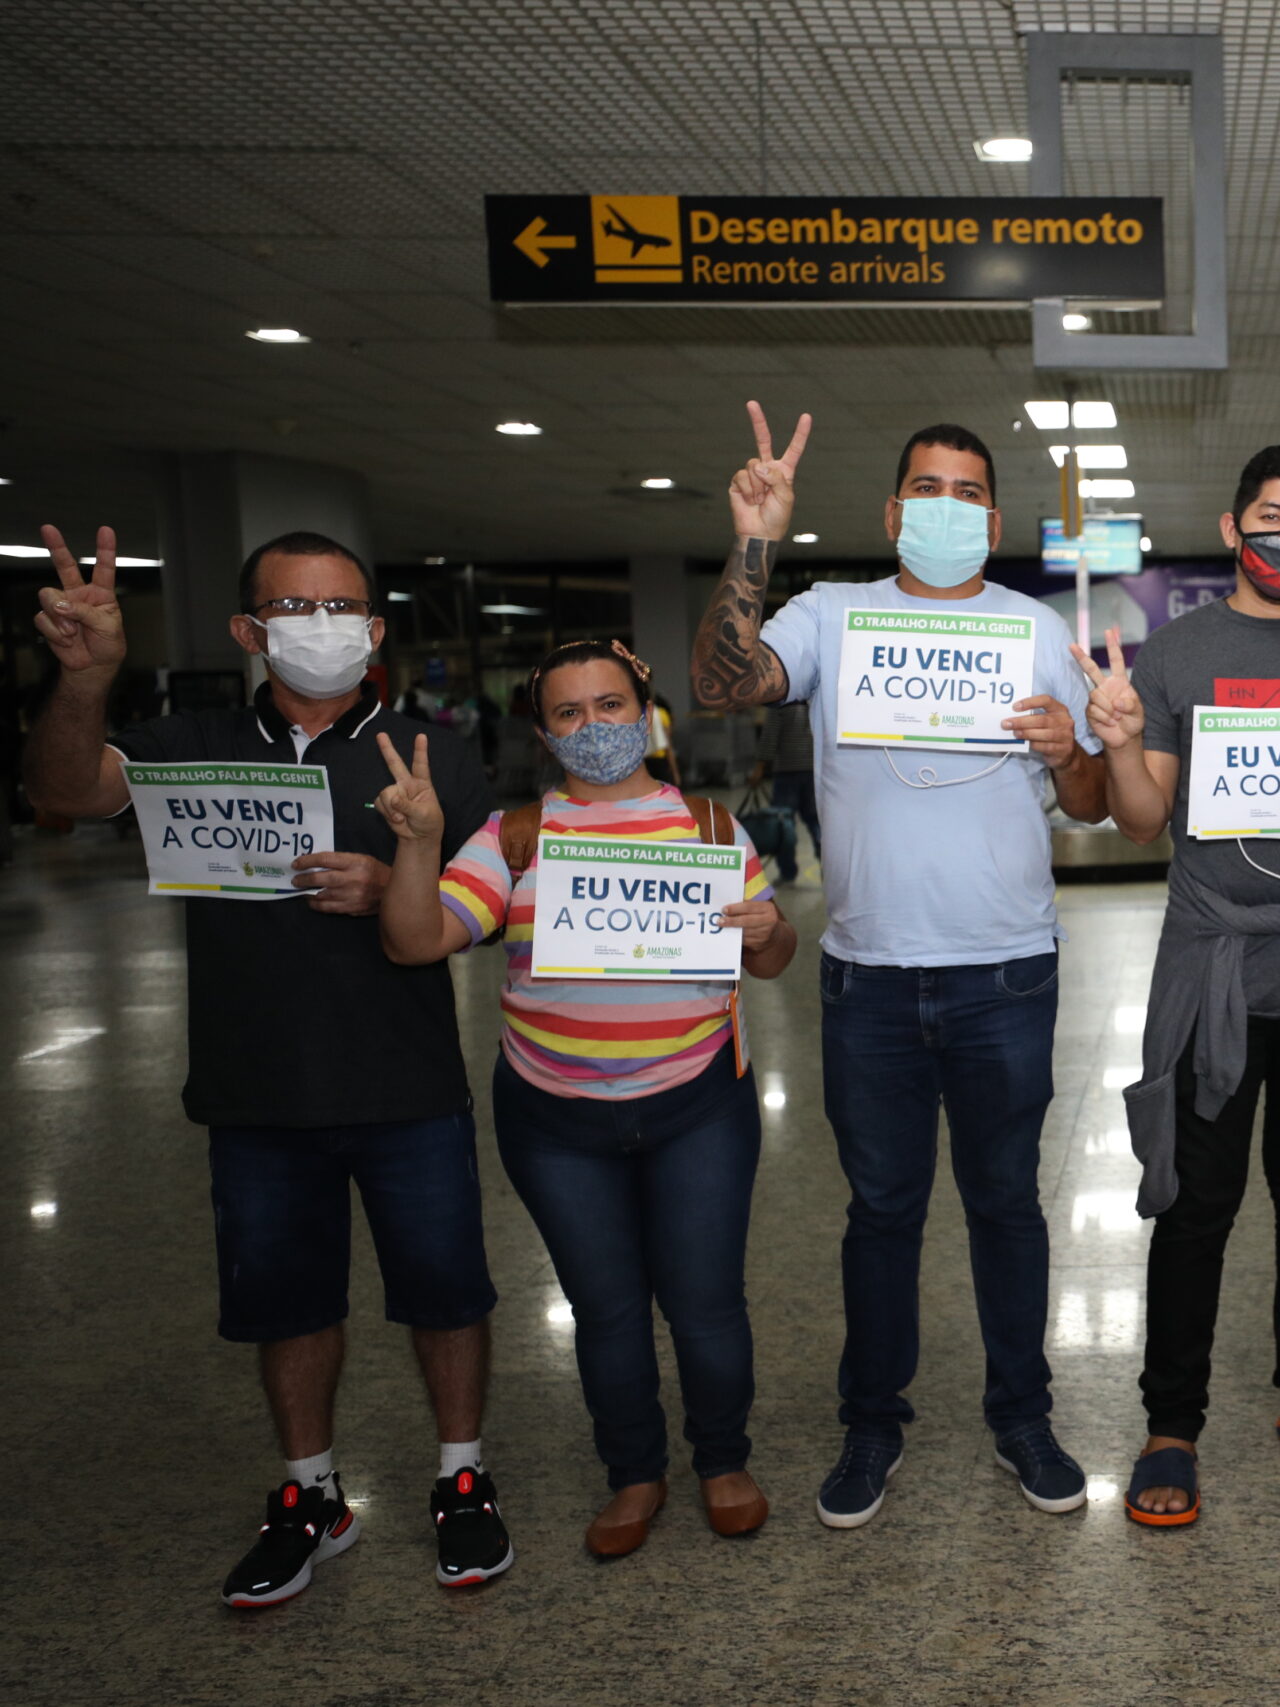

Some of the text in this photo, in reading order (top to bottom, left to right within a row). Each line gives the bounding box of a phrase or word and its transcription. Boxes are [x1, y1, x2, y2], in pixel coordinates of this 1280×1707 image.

[690, 208, 1144, 252] Desembarque remoto
[692, 255, 945, 284] Remote arrivals
[853, 616, 1025, 635] O TRABALHO FALA PELA GENTE
[872, 645, 1002, 674] EU VENCI
[855, 674, 1014, 704] A COVID-19
[942, 715, 975, 726] AMAZONAS
[1204, 718, 1214, 728] O
[1216, 717, 1277, 728] TRABALHO
[1226, 747, 1259, 768] EU
[133, 771, 319, 785] O TRABALHO FALA PELA GENTE
[1212, 775, 1231, 796] A
[166, 798, 304, 825] EU VENCI
[162, 826, 314, 856] A COVID-19
[549, 845, 735, 866] O TRABALHO FALA PELA GENTE
[571, 876, 711, 905] EU VENCI
[553, 907, 724, 934] A COVID-19
[646, 946, 682, 957] AMAZONAS
